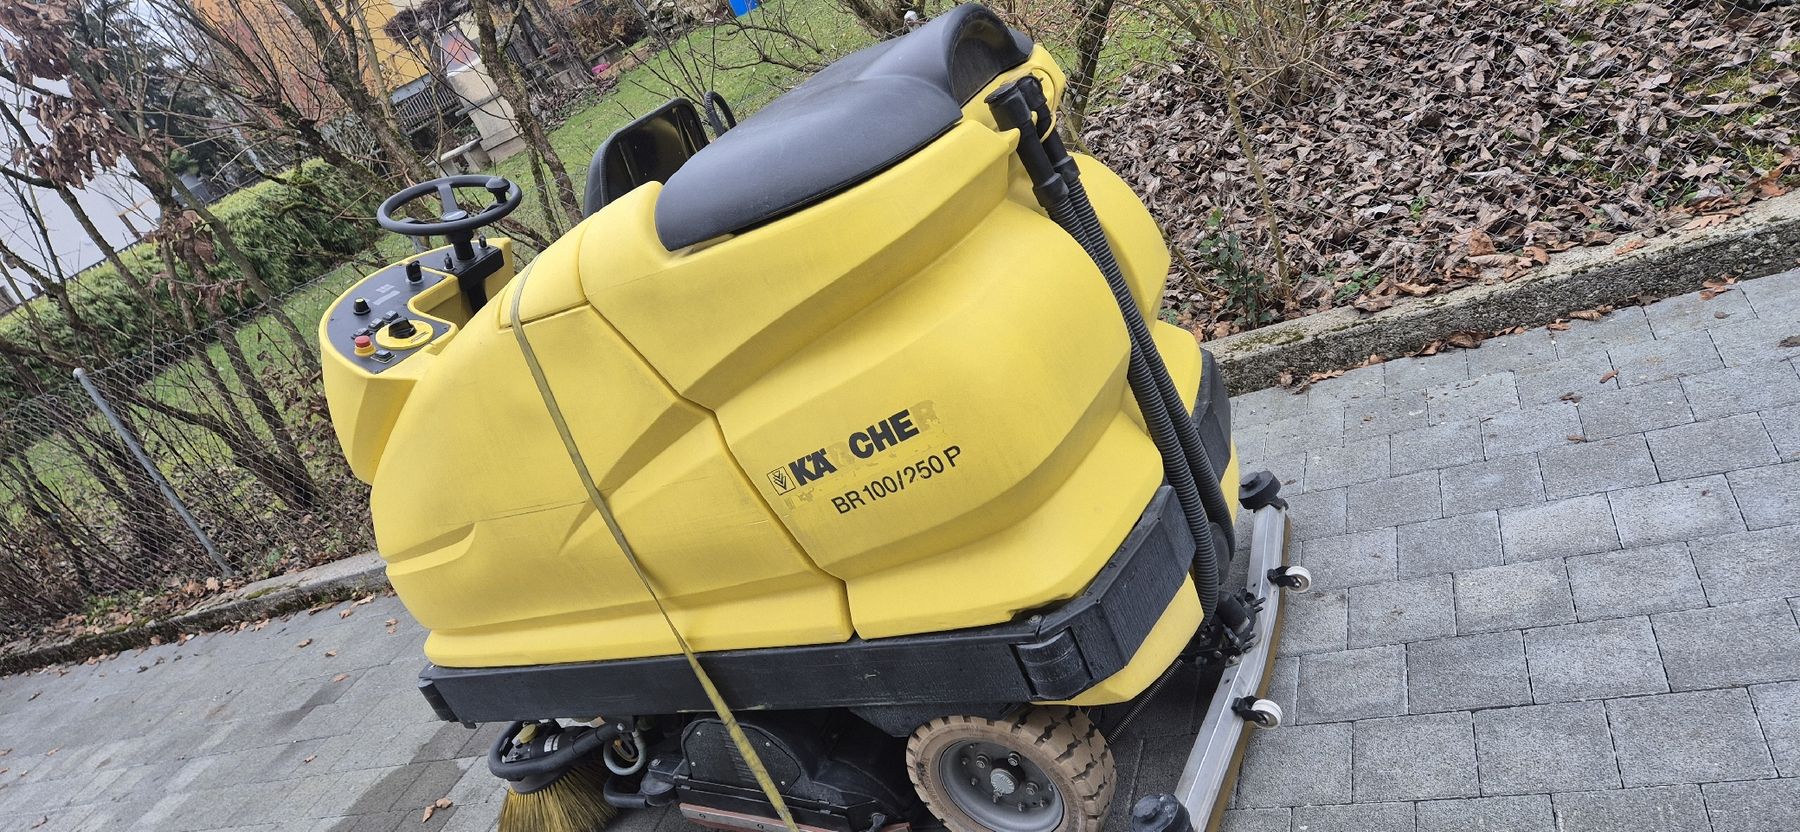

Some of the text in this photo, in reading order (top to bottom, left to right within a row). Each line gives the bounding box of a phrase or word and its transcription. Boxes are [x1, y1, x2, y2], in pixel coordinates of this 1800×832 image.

[787, 400, 940, 487] KÄCHE
[831, 445, 961, 514] BR 100/250 P
